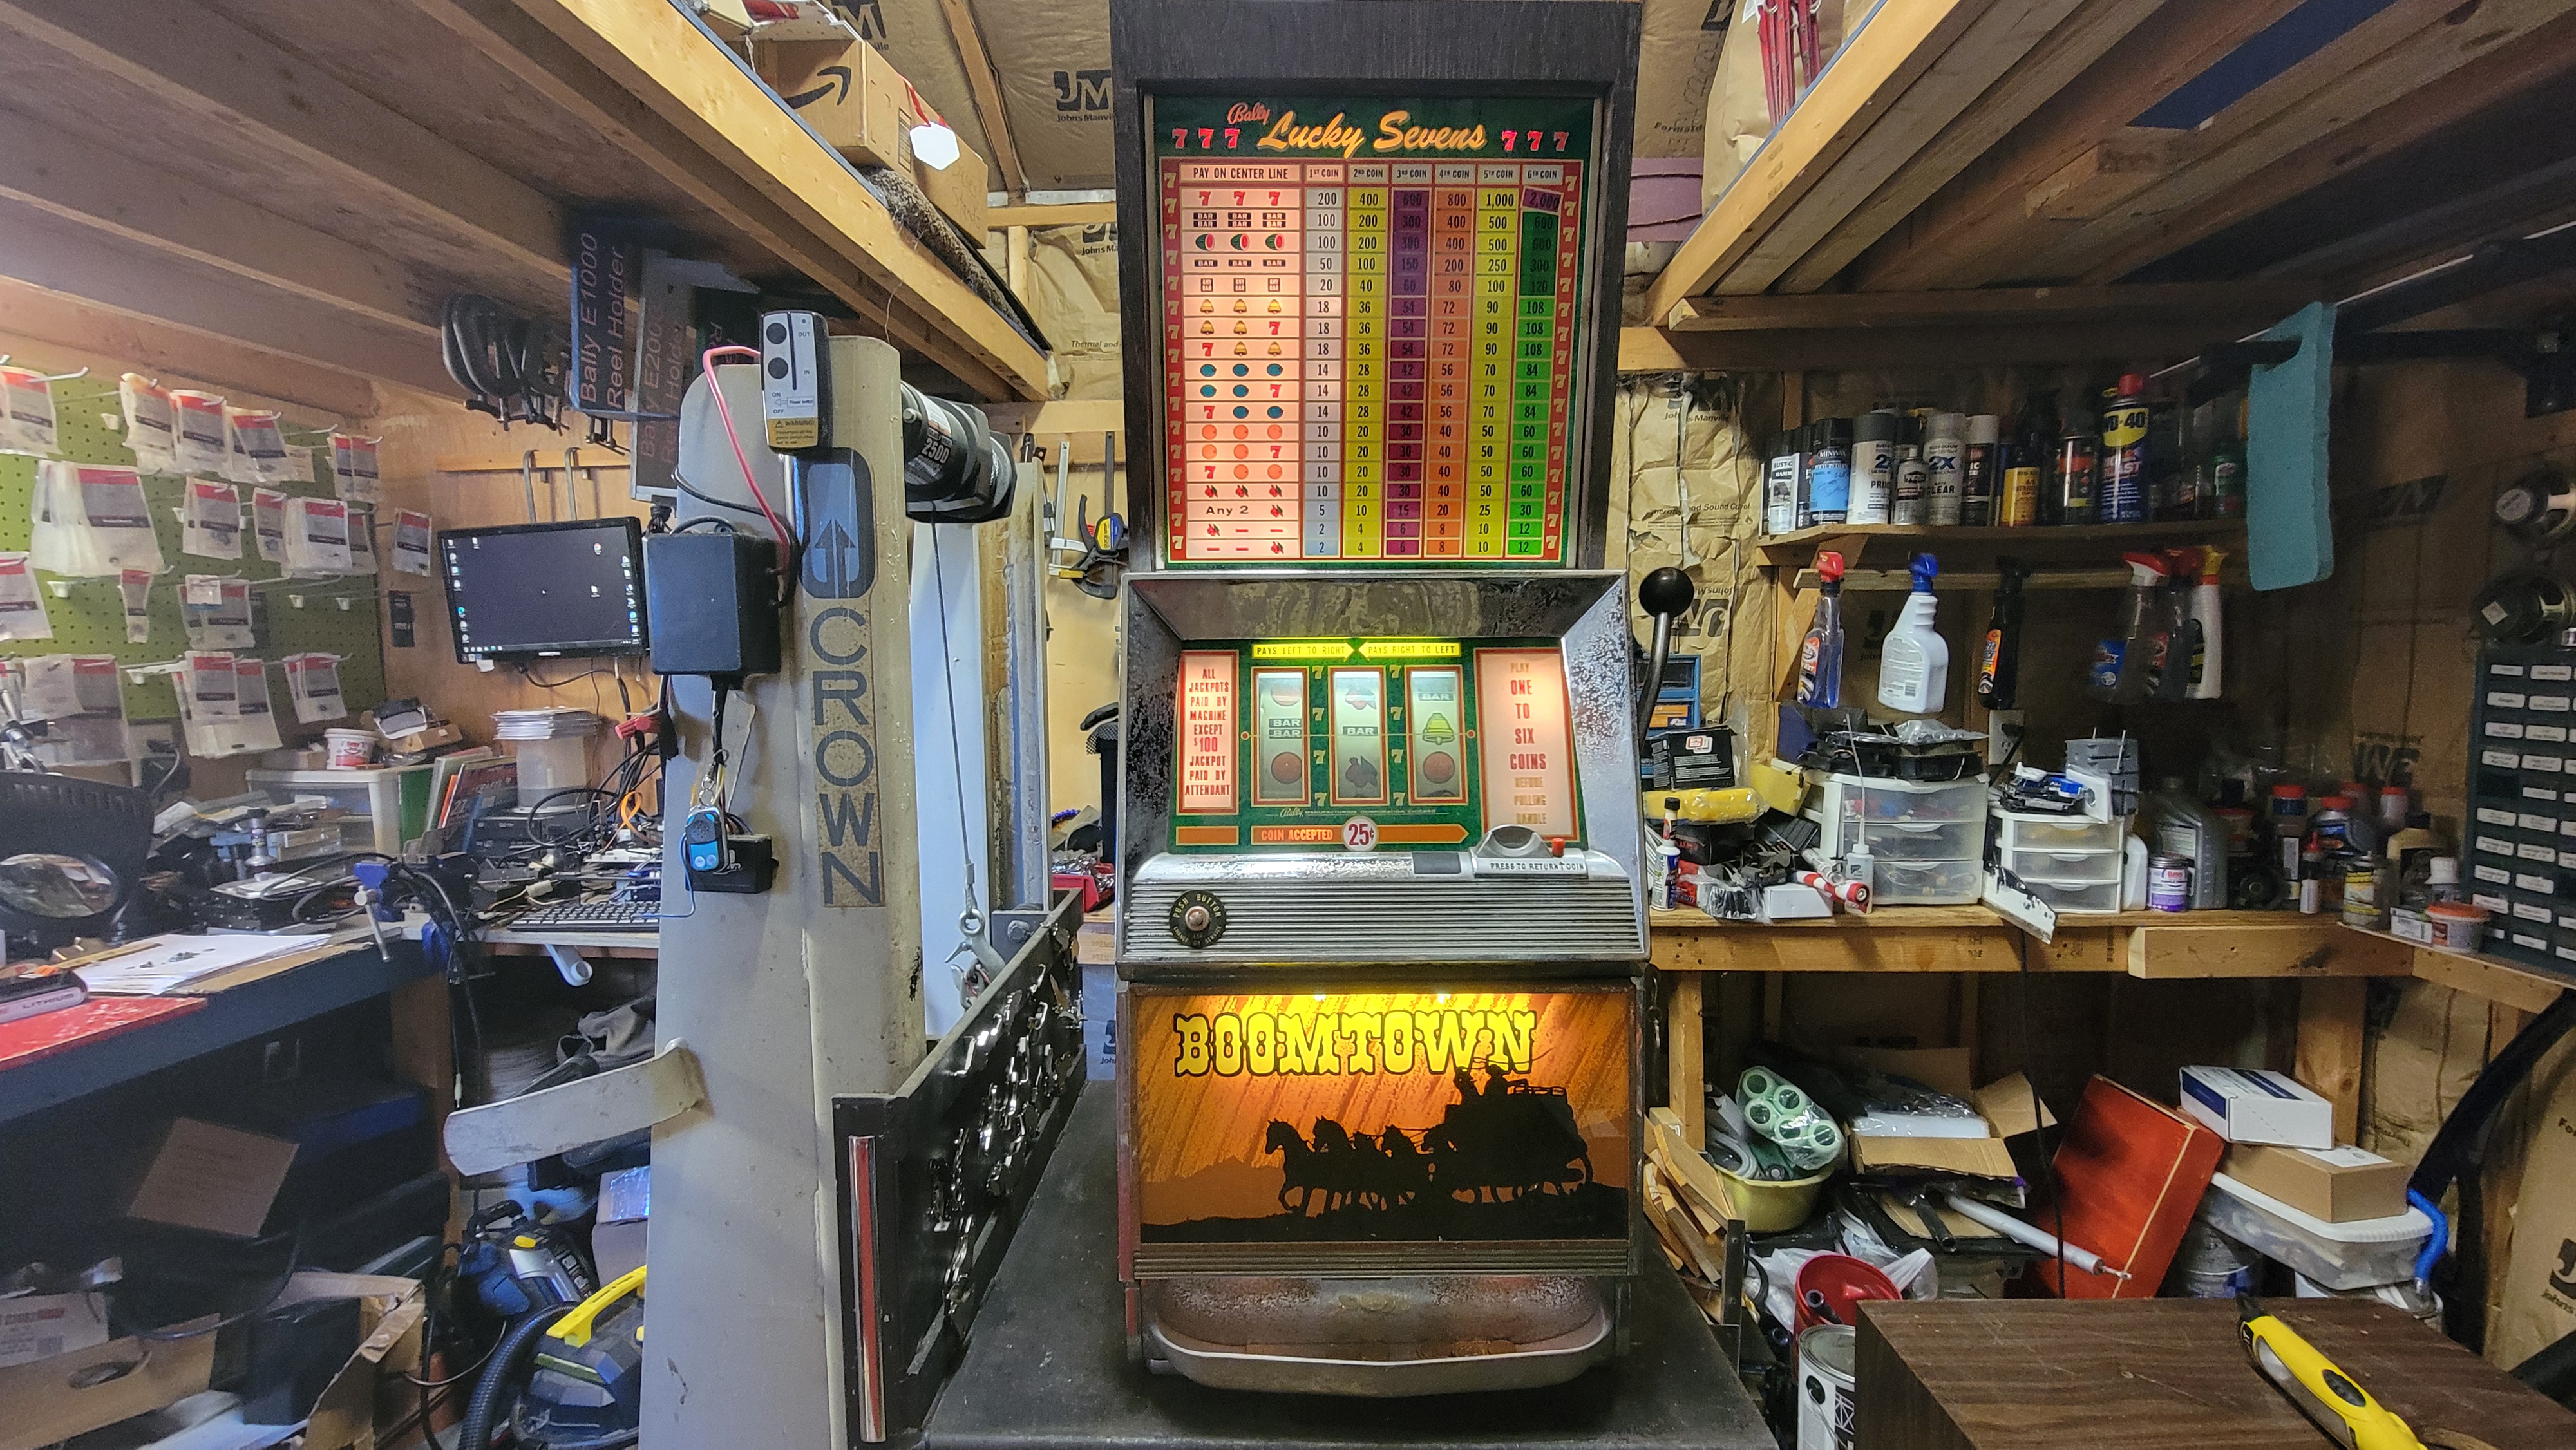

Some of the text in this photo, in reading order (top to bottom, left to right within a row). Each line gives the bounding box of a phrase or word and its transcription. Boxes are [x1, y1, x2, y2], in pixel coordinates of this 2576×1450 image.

[1057, 114, 1082, 122] Johns
[1227, 102, 1270, 125] Bally
[1172, 109, 1569, 159] 7 7 7 Lucky Sevens 7 7 7
[1193, 167, 1288, 179] PAY ON CENTER LINE
[1321, 169, 1339, 177] COIN
[1367, 169, 1383, 178] COIN
[1410, 169, 1427, 178] COIN
[1452, 169, 1470, 178] COIN
[1496, 170, 1513, 178] COIN
[1540, 170, 1557, 178] COIN
[1199, 191, 1211, 206] 7
[1233, 191, 1246, 206] 7
[1268, 191, 1281, 206] 7
[1318, 192, 1337, 205] 200
[1359, 193, 1378, 206] 400
[1447, 193, 1466, 207] 800
[1486, 193, 1514, 209] 1,000
[1082, 245, 1105, 256] Johns
[1320, 278, 1332, 291] 20
[1359, 279, 1372, 292] 40
[1448, 279, 1461, 293] 80
[1488, 279, 1505, 292] 100
[607, 245, 624, 409] Reel Holder
[1071, 340, 1102, 348] Thermal
[580, 333, 601, 402] Bally
[1318, 362, 1538, 377] 14 28 42 56 70 84
[1318, 423, 1535, 438] 10 20 30 40 50 60
[922, 438, 950, 464] 2500
[1929, 455, 1956, 471] 2X
[1206, 504, 1531, 516] Any 2 5 10 15 20 25 30
[1322, 646, 1345, 654] RIGHT
[1368, 646, 1388, 654] PAYS
[1202, 668, 1216, 679] ALL
[1189, 682, 1229, 693] JACKPOTS
[1510, 679, 1532, 695] ONE
[1191, 696, 1227, 707] PAID BY
[1190, 710, 1227, 721] MACHINE
[1515, 703, 1530, 719] TO
[1193, 724, 1223, 735] EXCEPT
[1515, 728, 1535, 744] SIX
[1193, 737, 1218, 752] $100
[810, 607, 881, 905] CROWN
[1189, 755, 1226, 766] JACKPOT
[1510, 753, 1547, 770] COINS
[1189, 769, 1226, 780] PAID BY
[1184, 784, 1231, 796] ATTENDANT
[1514, 795, 1547, 806] PULLING
[1261, 829, 1333, 841] COIN ACCEPTED
[1348, 824, 1375, 845] 25¢
[1173, 893, 1222, 918] PUSH BUTTON
[1173, 1010, 1537, 1077] BOOMTOWN
